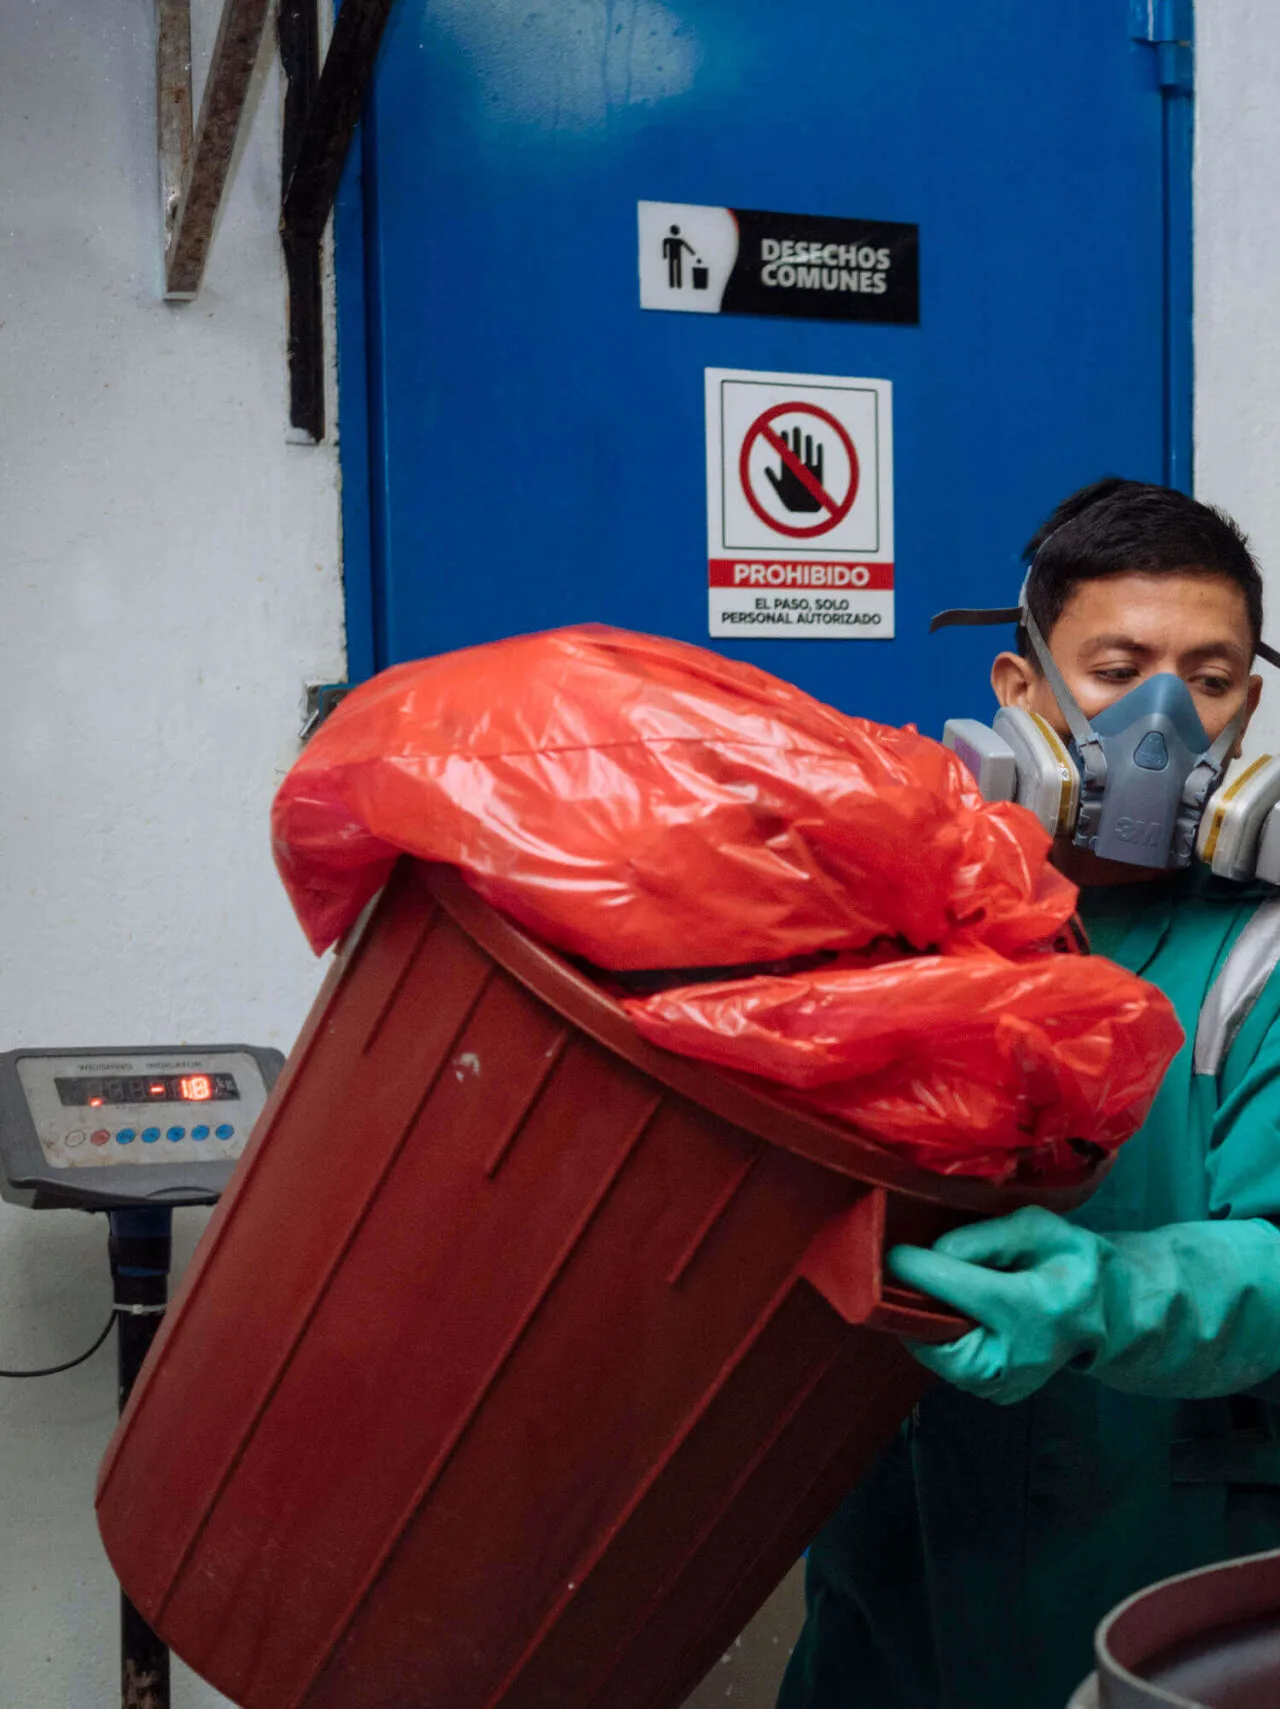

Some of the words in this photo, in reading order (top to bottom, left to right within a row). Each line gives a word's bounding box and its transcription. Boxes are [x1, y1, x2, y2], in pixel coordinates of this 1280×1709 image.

[761, 239, 890, 270] DESECHOS
[761, 264, 887, 294] COMUNES
[733, 564, 870, 586] PROHIBIDO
[755, 598, 770, 610] EL
[774, 598, 812, 612] PASO,
[815, 599, 849, 611] SOLO
[722, 612, 792, 624] PERSONAL
[797, 613, 881, 625] AUTORIZADO
[1115, 817, 1161, 847] 3M
